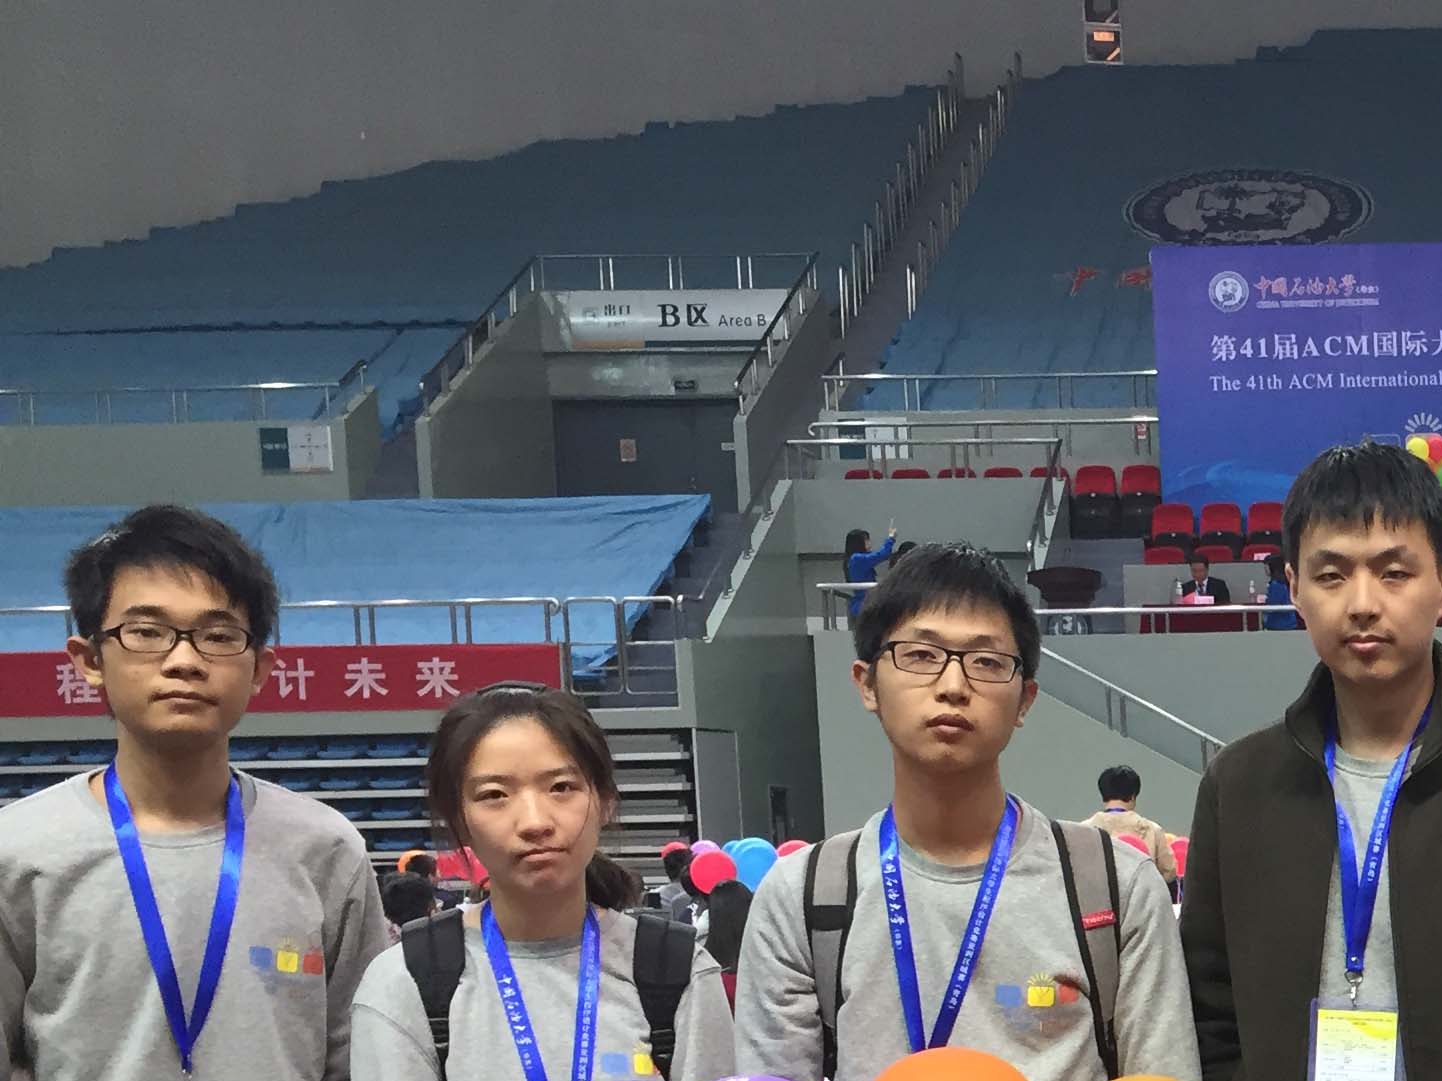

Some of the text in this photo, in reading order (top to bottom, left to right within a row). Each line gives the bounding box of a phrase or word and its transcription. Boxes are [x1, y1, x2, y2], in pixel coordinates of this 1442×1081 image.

[718, 315, 751, 326] Area
[757, 314, 766, 326] B
[1209, 375, 1241, 391] The
[1246, 374, 1282, 391] 41th
[1289, 372, 1333, 390] ACM
[1340, 369, 1442, 388] International
